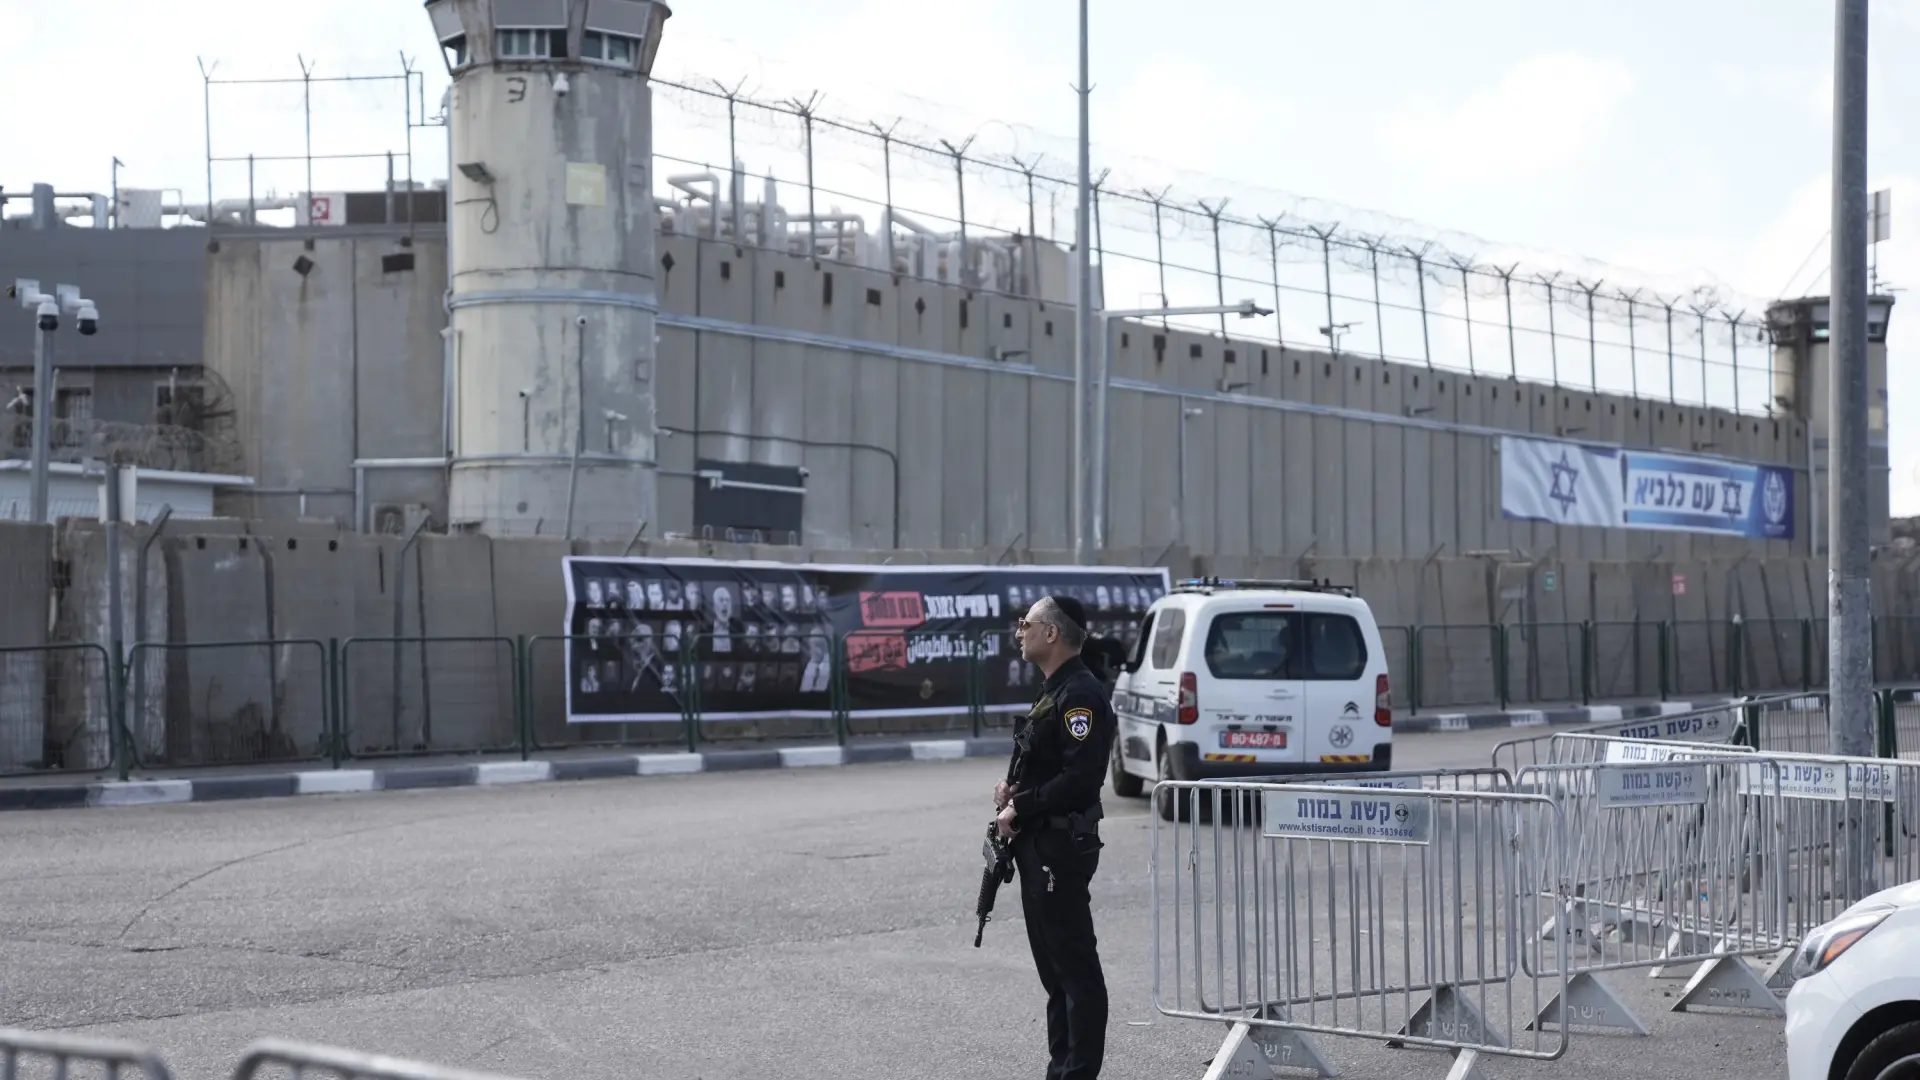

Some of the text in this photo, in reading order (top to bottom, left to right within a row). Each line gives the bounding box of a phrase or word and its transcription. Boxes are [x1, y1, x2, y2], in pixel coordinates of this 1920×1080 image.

[1634, 473, 1715, 512] עם כלביא
[1216, 713, 1292, 723] משטרת ישראל
[1667, 717, 1703, 735] קשת
[1622, 745, 1647, 760] במות
[1622, 771, 1682, 791] קשת במות
[1794, 765, 1822, 785] קשת
[1297, 798, 1391, 826] קשת במות
[1278, 822, 1413, 838] www.kstisrael.co.il 02-5839696
